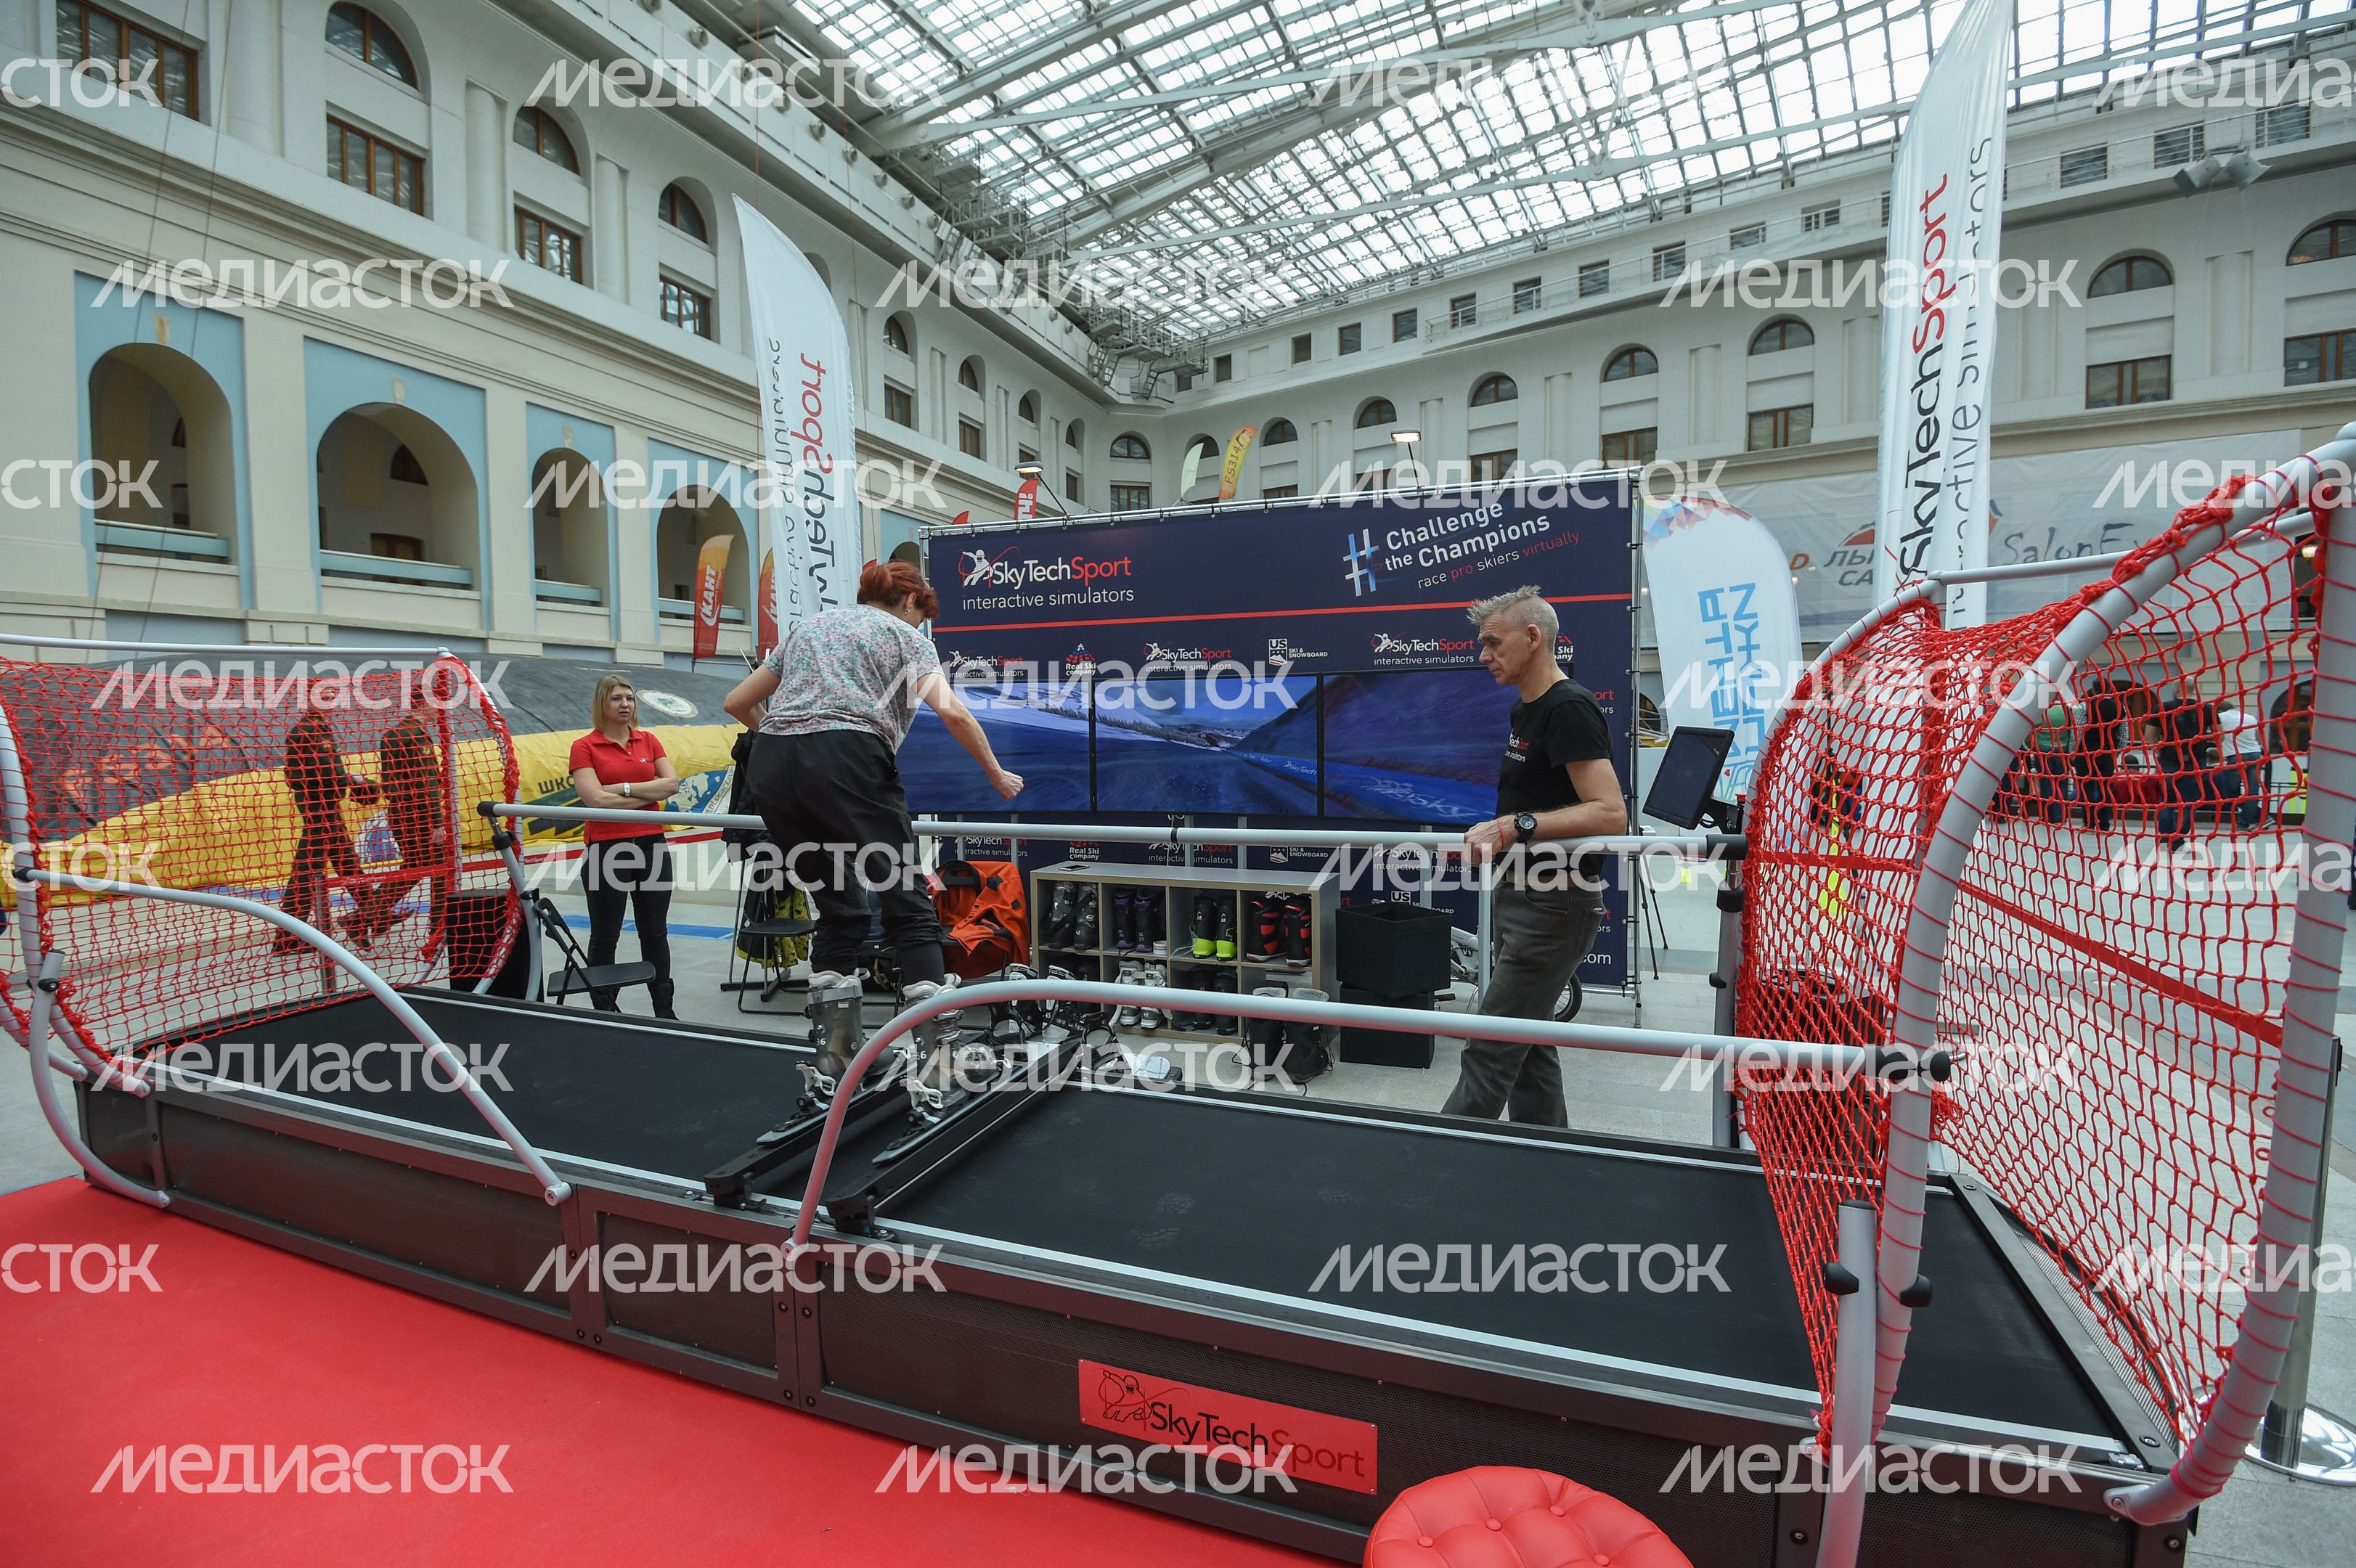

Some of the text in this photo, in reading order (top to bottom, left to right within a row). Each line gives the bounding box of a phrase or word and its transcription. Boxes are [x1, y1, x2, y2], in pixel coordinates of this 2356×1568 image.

[1899, 172, 1957, 576] SkyTechSport
[1385, 502, 1504, 550] Challenge
[1385, 515, 1551, 572] the Champions
[1417, 531, 1581, 589] race pro skiers virtually
[990, 556, 1132, 589] SkyTechSport
[963, 587, 1135, 610] interactive simulators
[1270, 639, 1287, 649] US
[1391, 638, 1475, 655] SkyTechSport
[1557, 645, 1574, 654] Ski
[963, 655, 1024, 669] SkyTechSport
[1161, 647, 1231, 662] SkyTechSport
[1374, 654, 1475, 666] interactive simulators
[950, 669, 1024, 679] interactive simulators
[1146, 662, 1232, 673] interactive simulators
[1392, 891, 1411, 902] US
[1149, 1400, 1366, 1478] SkyTechSport
